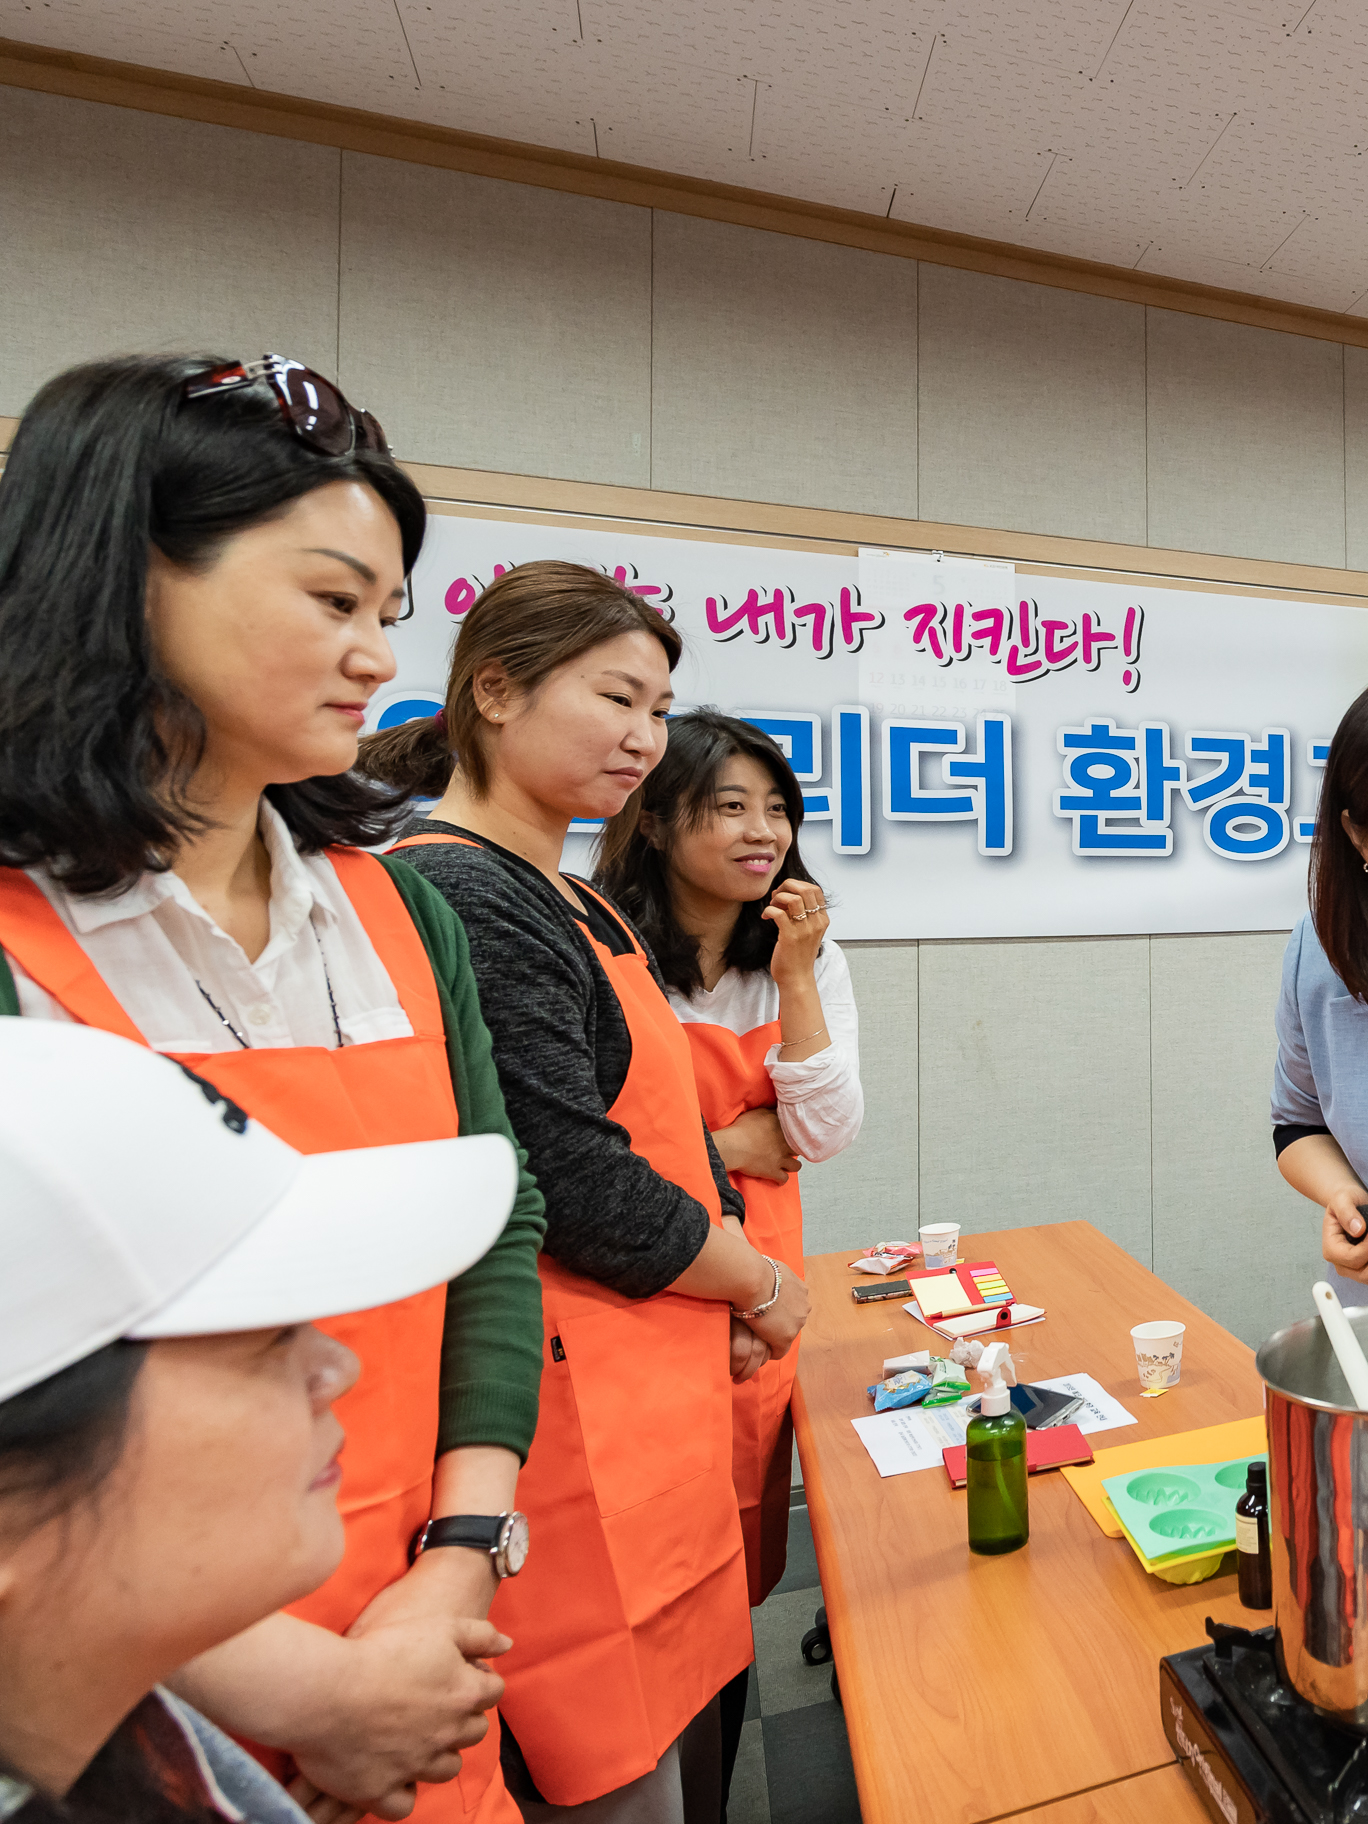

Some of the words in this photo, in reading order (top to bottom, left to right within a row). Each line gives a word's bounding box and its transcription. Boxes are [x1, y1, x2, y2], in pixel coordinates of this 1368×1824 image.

[704, 586, 880, 656] 내가
[903, 599, 1142, 690] 지킨다!
[1057, 722, 1330, 855] 환경
